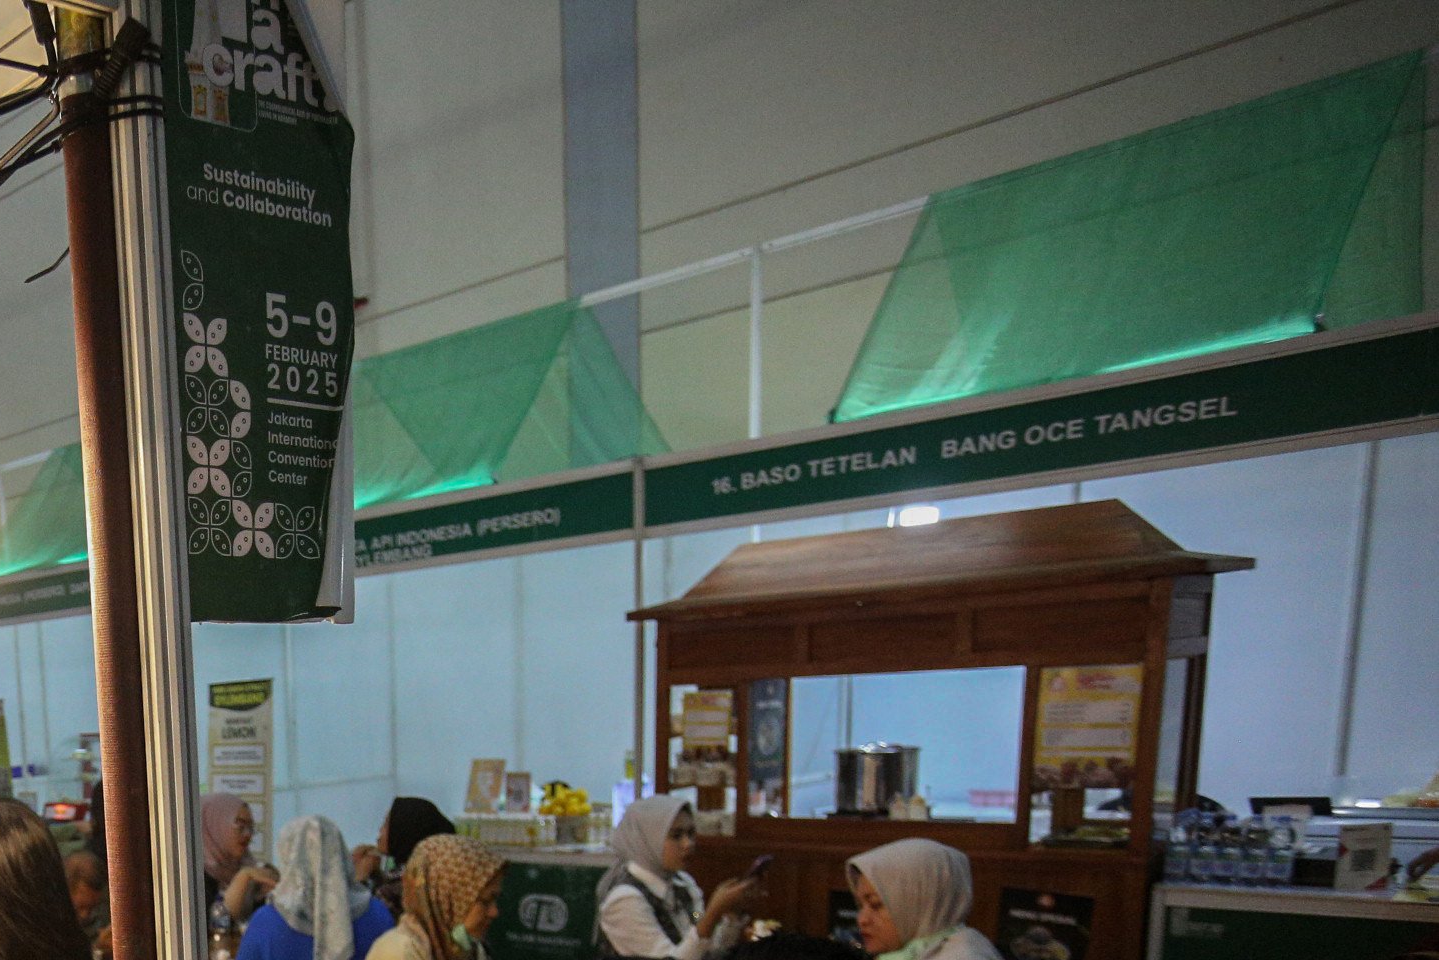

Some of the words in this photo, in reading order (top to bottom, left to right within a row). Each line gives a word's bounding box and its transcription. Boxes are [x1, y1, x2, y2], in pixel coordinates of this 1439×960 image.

[204, 163, 316, 209] Sustainability
[187, 185, 219, 204] and
[222, 190, 332, 228] Collaboration
[265, 343, 338, 369] FEBRUARY
[267, 363, 339, 398] 2025
[267, 412, 313, 429] Jakarta
[740, 463, 802, 491] BASO
[807, 446, 918, 478] TETELAN
[940, 429, 1018, 460] BANG
[1023, 418, 1086, 447] OCE
[1093, 396, 1239, 435] TANGSEL
[268, 470, 309, 486] Center
[394, 521, 473, 549] INDONESIA
[476, 507, 561, 537] (PERSERO)
